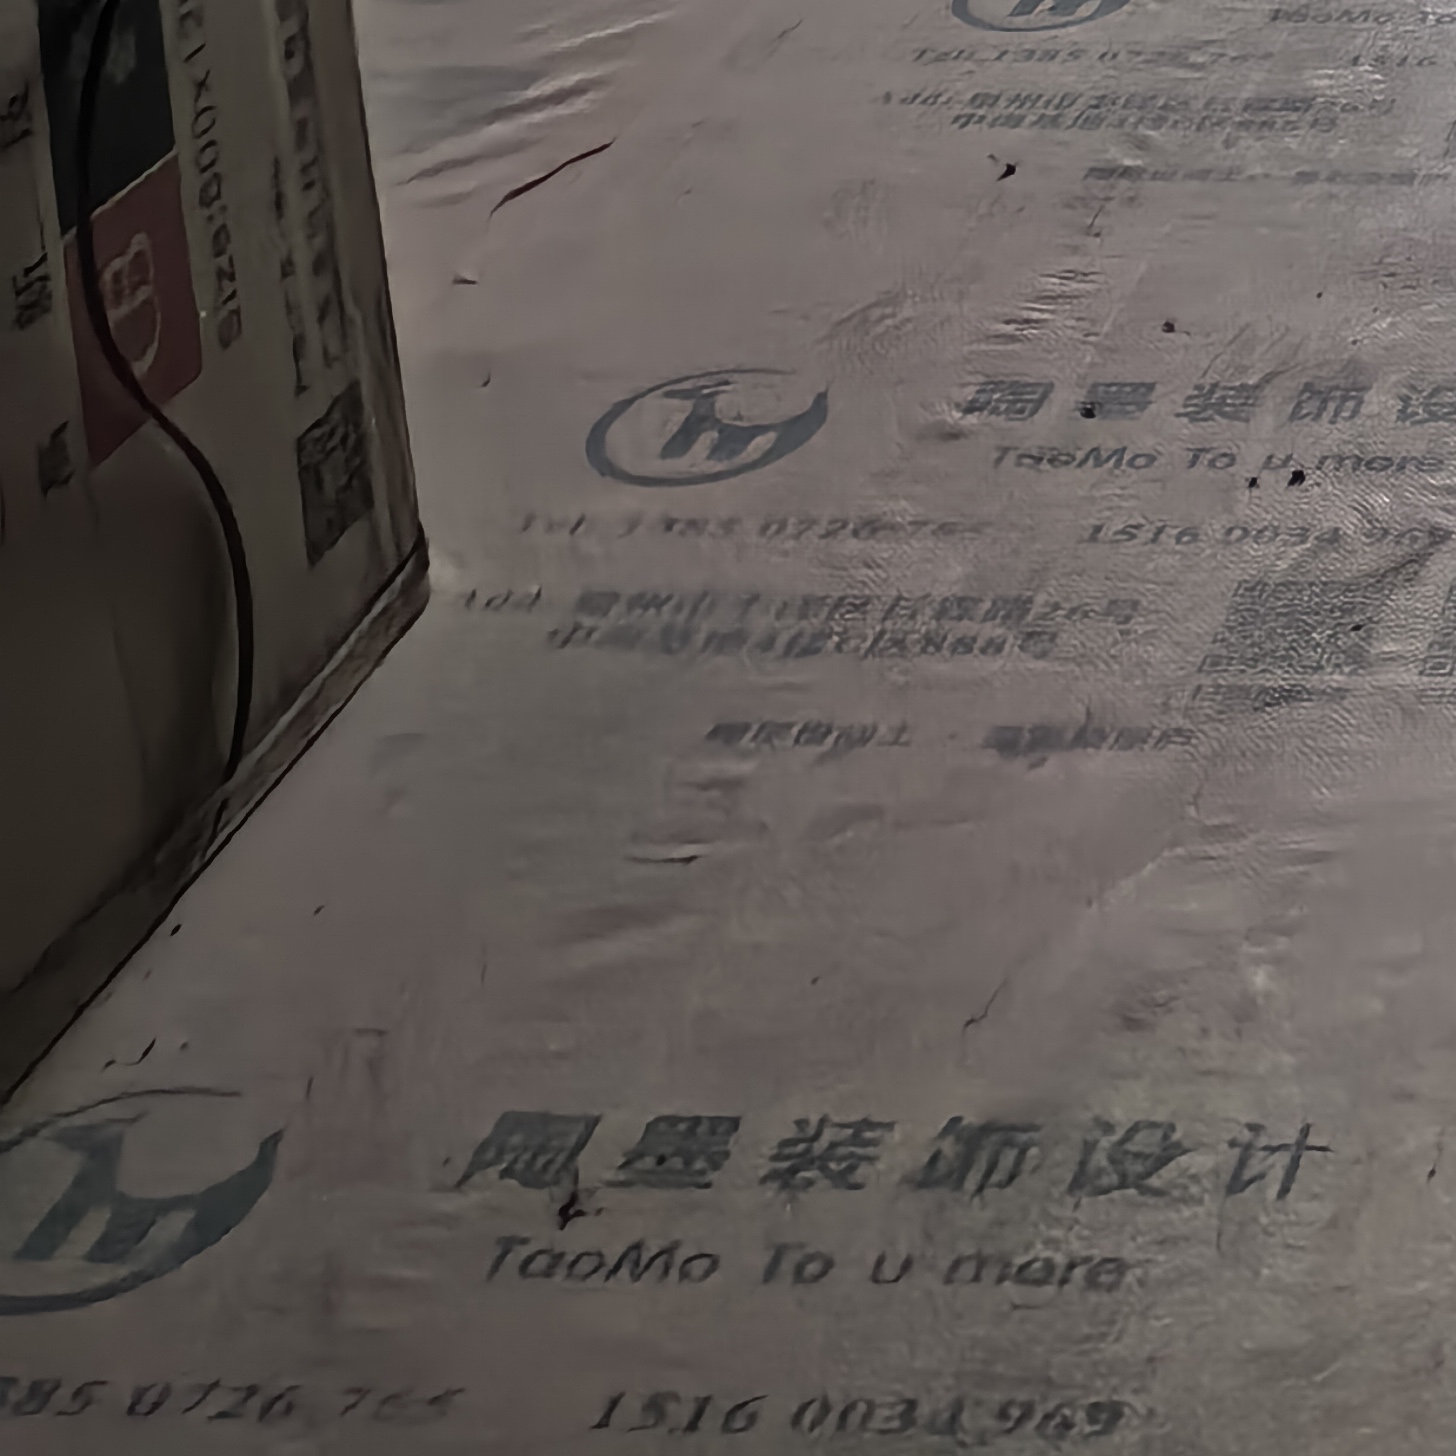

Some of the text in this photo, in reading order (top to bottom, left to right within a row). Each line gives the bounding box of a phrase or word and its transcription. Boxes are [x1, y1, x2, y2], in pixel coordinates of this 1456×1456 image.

[457, 1109, 1336, 1204] 陶墨装饰设计
[485, 1235, 720, 1288] TaoMo
[761, 1238, 834, 1287] To
[872, 1252, 914, 1287] u
[126, 1377, 304, 1423] 0726
[588, 1390, 770, 1435] 1516
